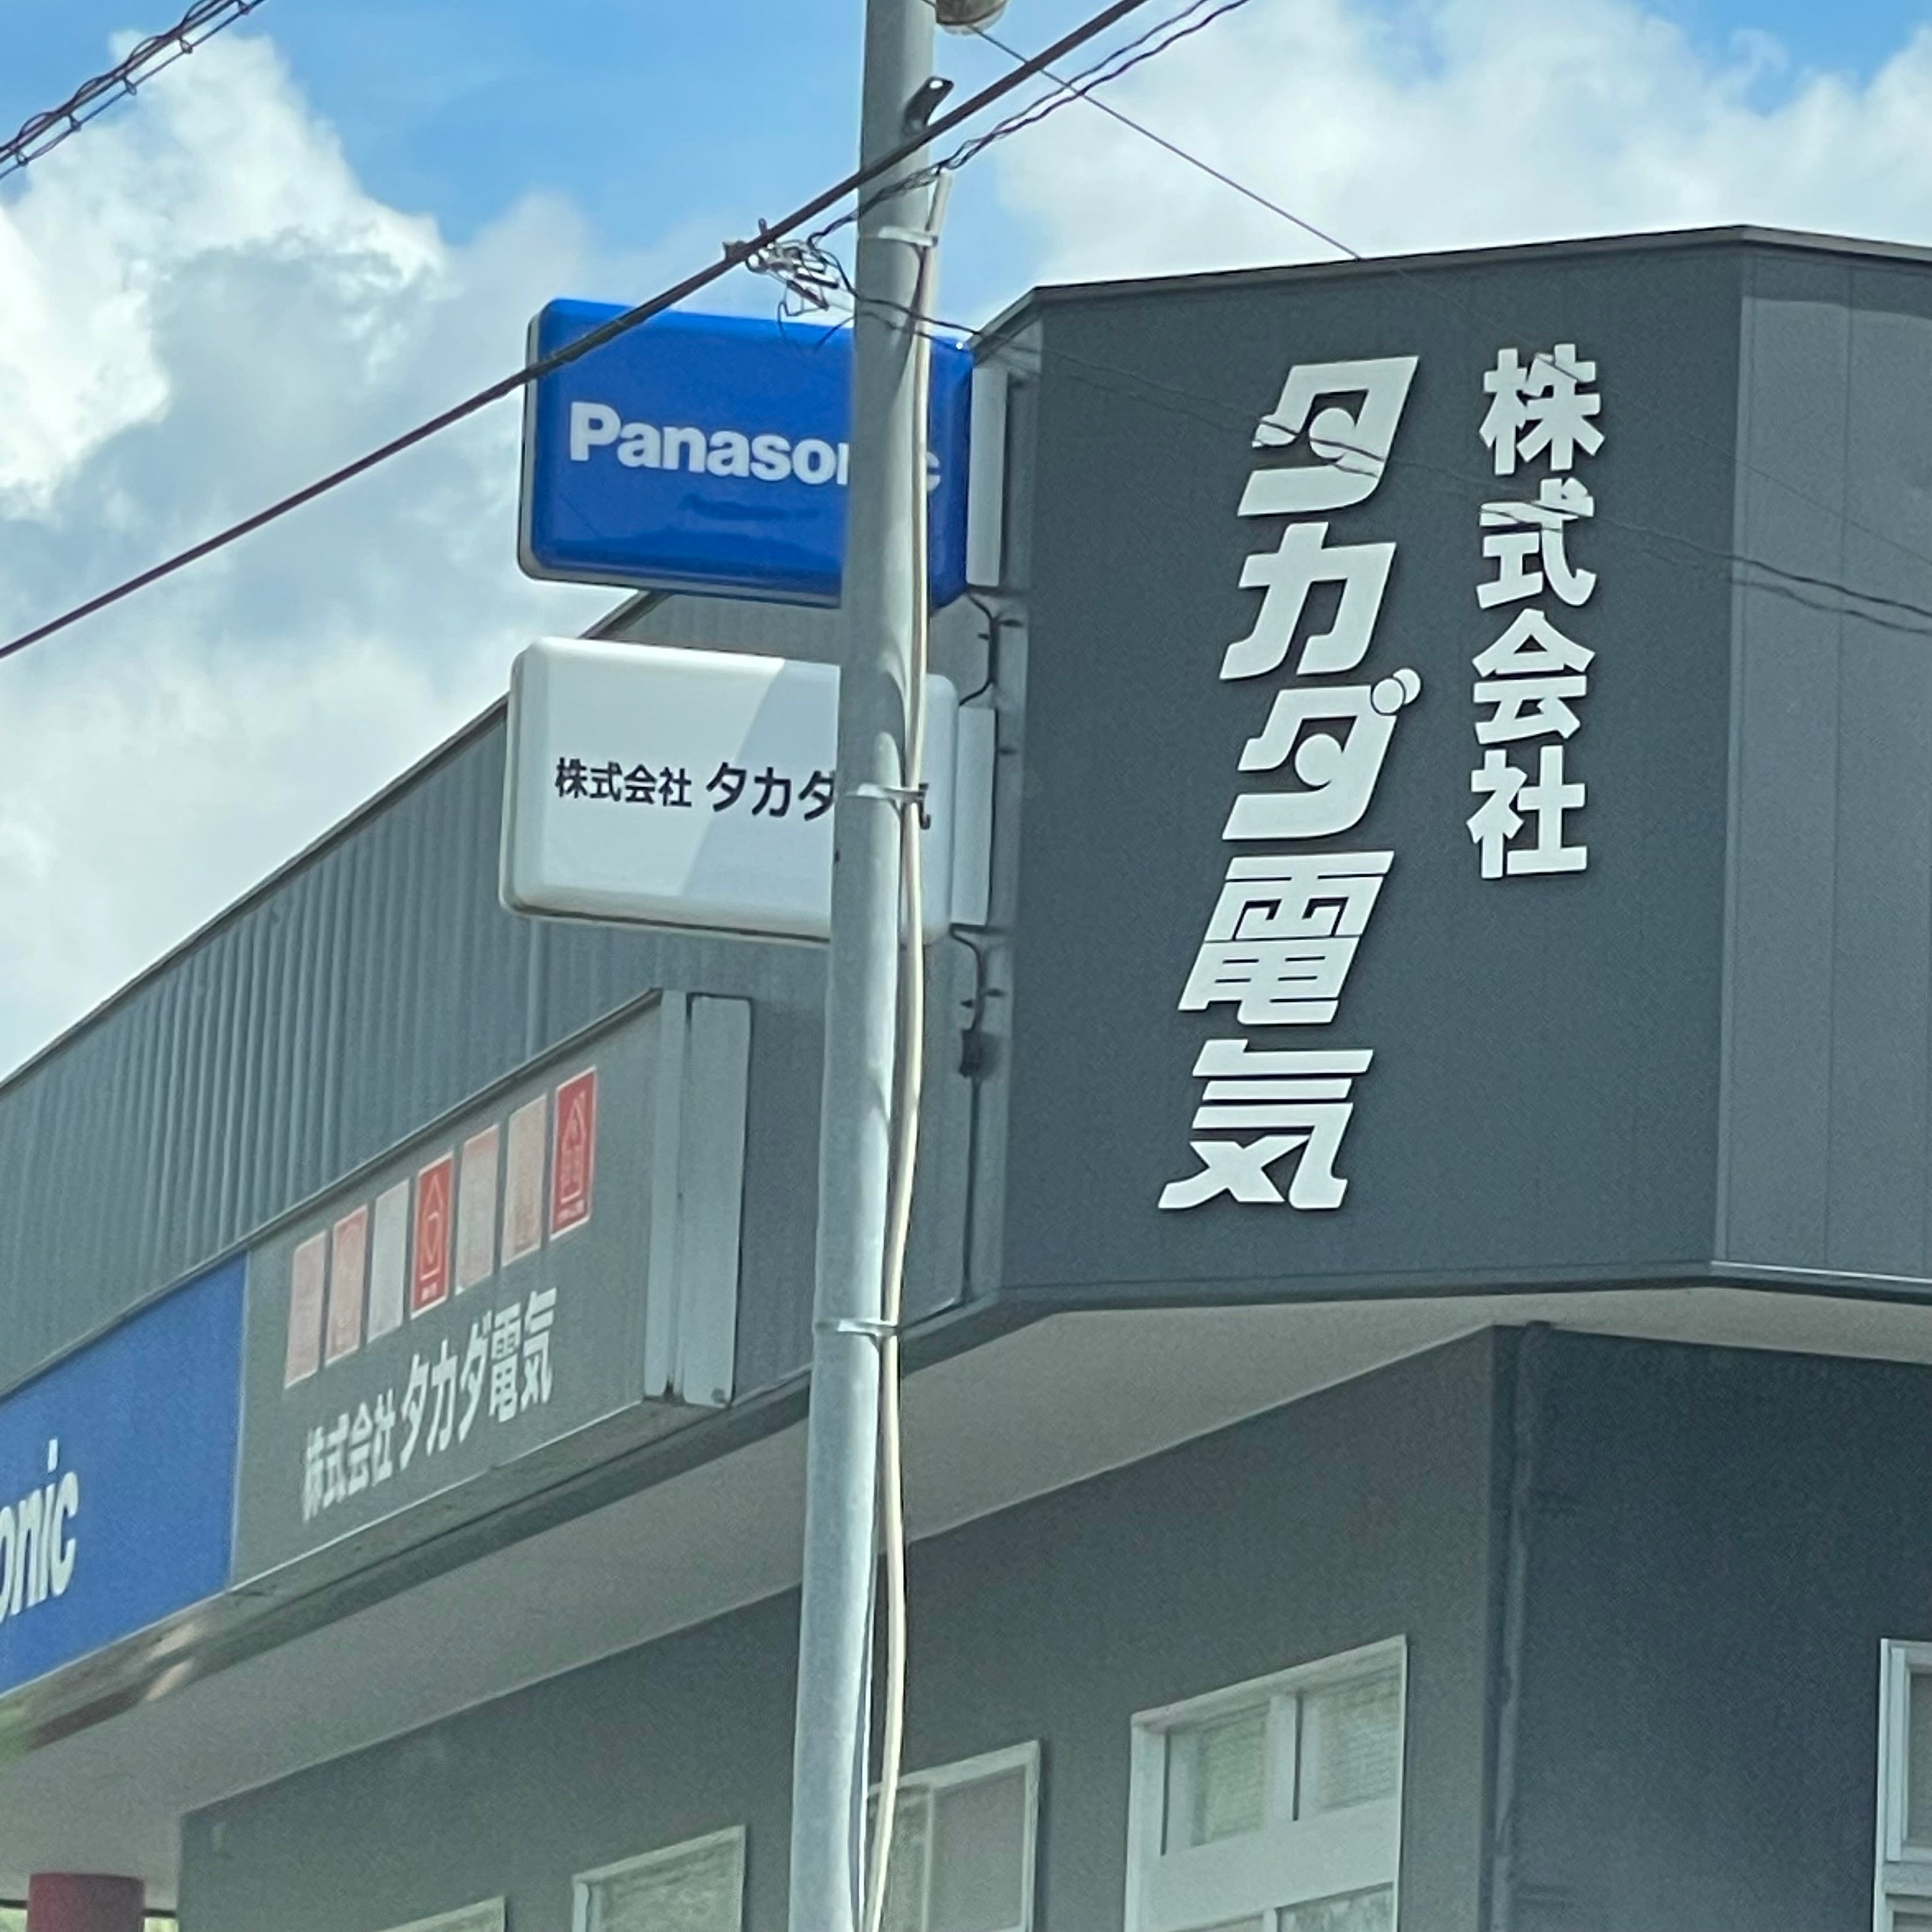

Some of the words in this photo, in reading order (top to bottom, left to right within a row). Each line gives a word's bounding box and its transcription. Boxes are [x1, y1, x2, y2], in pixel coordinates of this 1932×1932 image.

[570, 401, 941, 493] Panaso
[1467, 343, 1604, 880] 株式会社
[554, 758, 692, 807] 株式会社
[1158, 356, 1422, 1210] タカダ電気
[303, 1387, 396, 1523] 株式会社
[399, 1286, 556, 1471] タカダ電気
